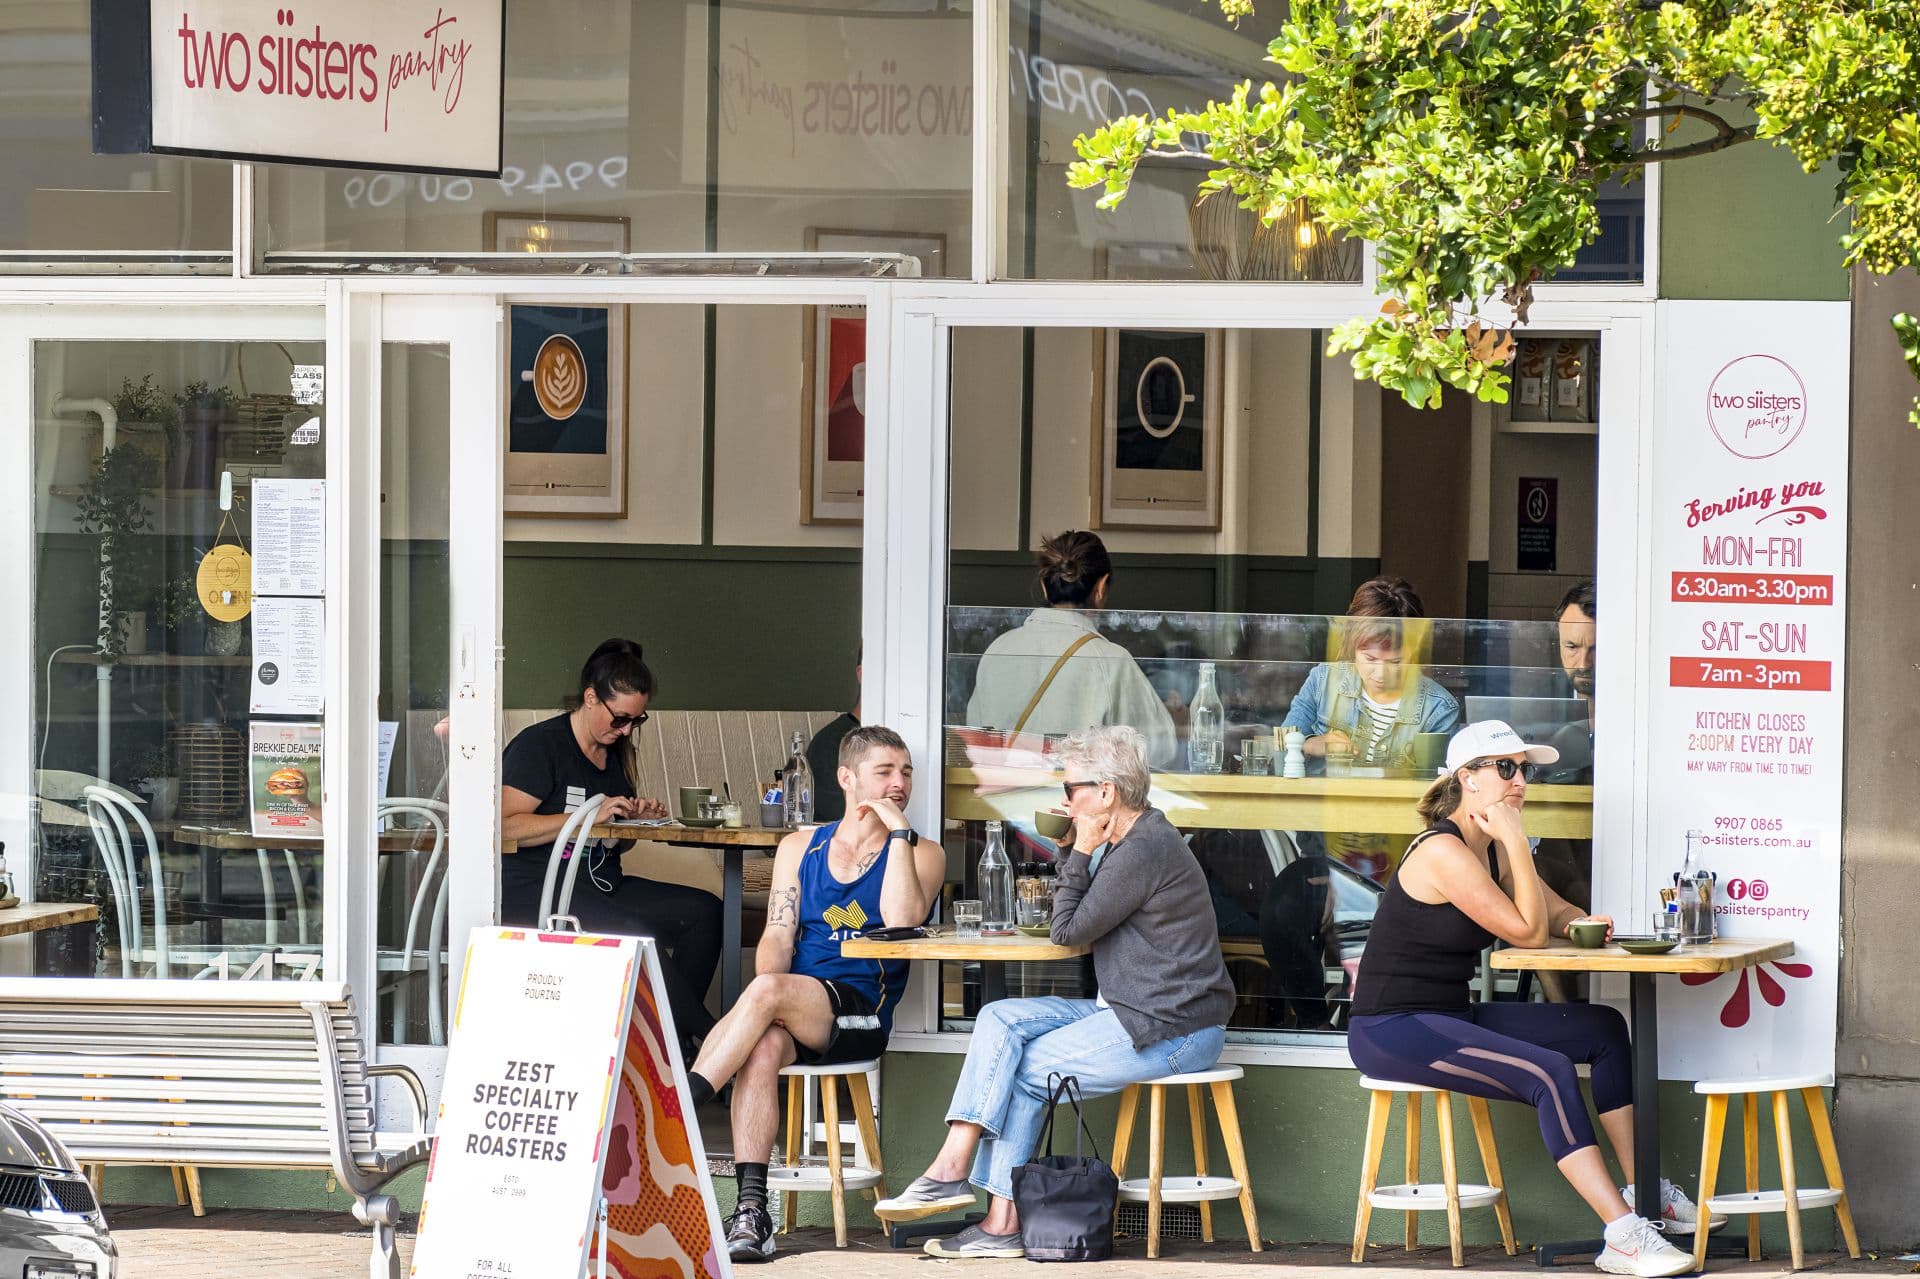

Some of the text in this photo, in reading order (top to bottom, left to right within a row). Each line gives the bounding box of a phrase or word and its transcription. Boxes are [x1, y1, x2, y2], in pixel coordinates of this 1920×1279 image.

[178, 8, 472, 132] two siisters pantry
[1712, 391, 1801, 410] two siisters
[1745, 409, 1793, 439] pantry
[1684, 481, 1825, 528] Serving you
[1677, 577, 1828, 604] 6.30am-3.30pm
[1696, 712, 1806, 732] KITCHEN CLOSES
[253, 743, 286, 753] BREKKIE
[287, 743, 308, 753] DEAL
[1688, 733, 1814, 754] 2:00PM EVERY DAY
[1687, 760, 1704, 771] MAY
[1707, 761, 1727, 772] VARY
[1730, 762, 1752, 773] FROM
[1756, 762, 1774, 774] TIME
[1777, 763, 1788, 774] TO
[1714, 817, 1783, 830] 9907 0865
[527, 973, 564, 985] PROUDLY
[525, 988, 560, 1000] POURING
[505, 1061, 555, 1083] ZEST
[473, 1083, 579, 1111] SPECIALTY
[485, 1110, 558, 1135] COFFEE
[466, 1133, 567, 1162] ROASTERS
[477, 1259, 512, 1272] FOR ALL
